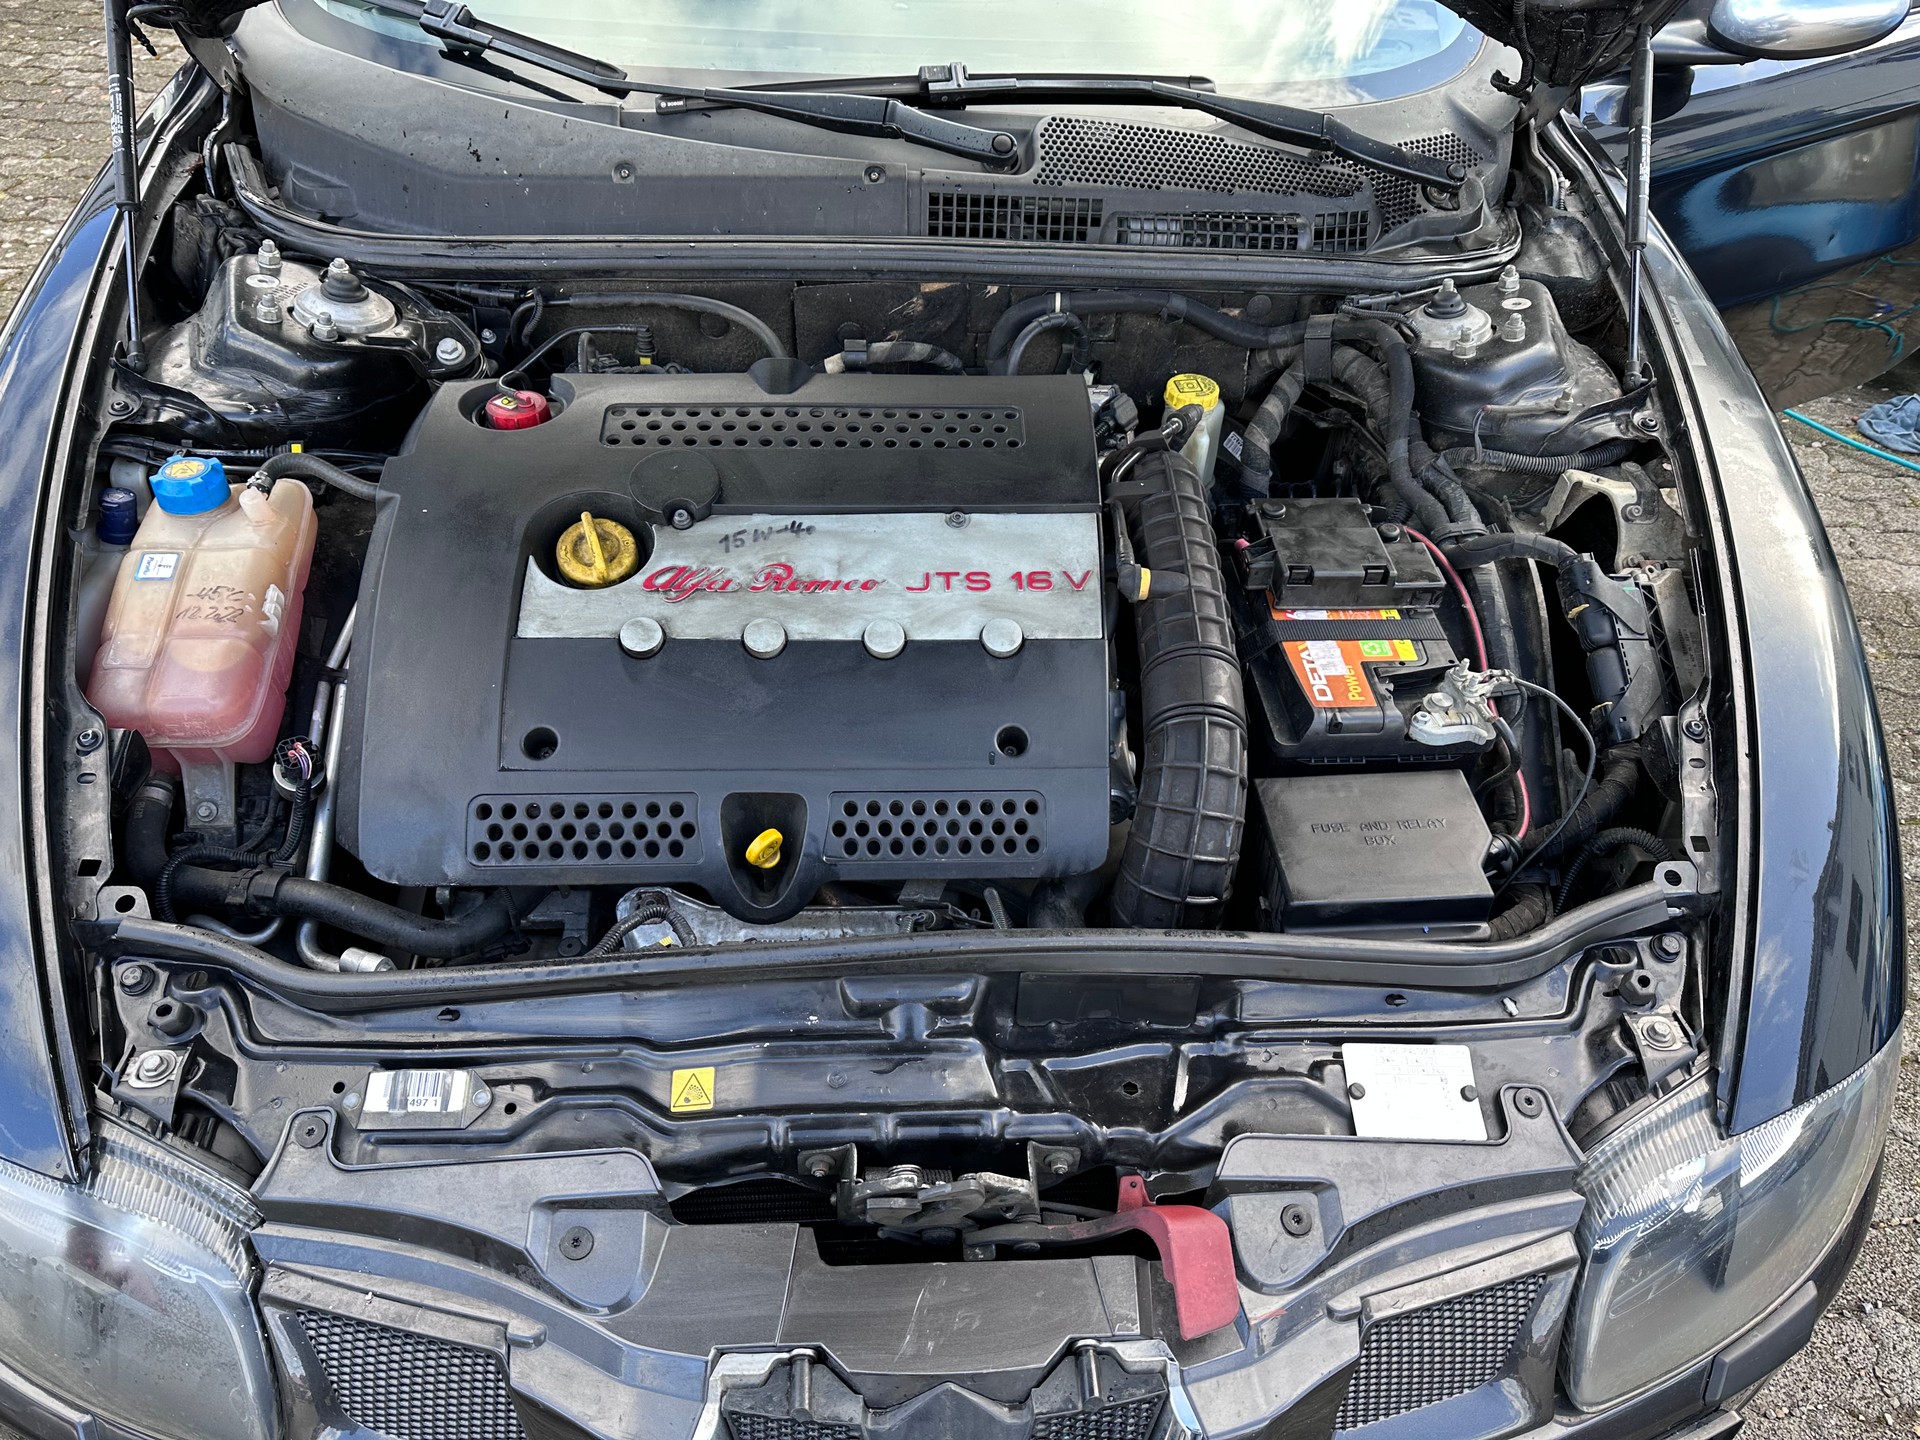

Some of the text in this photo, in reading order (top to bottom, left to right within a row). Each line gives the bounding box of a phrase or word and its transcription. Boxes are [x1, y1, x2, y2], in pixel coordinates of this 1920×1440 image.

[642, 565, 742, 602] Alfa
[905, 571, 991, 592] JTS
[1311, 818, 1447, 834] FUSE AND RELAY
[1363, 834, 1398, 847] BOX
